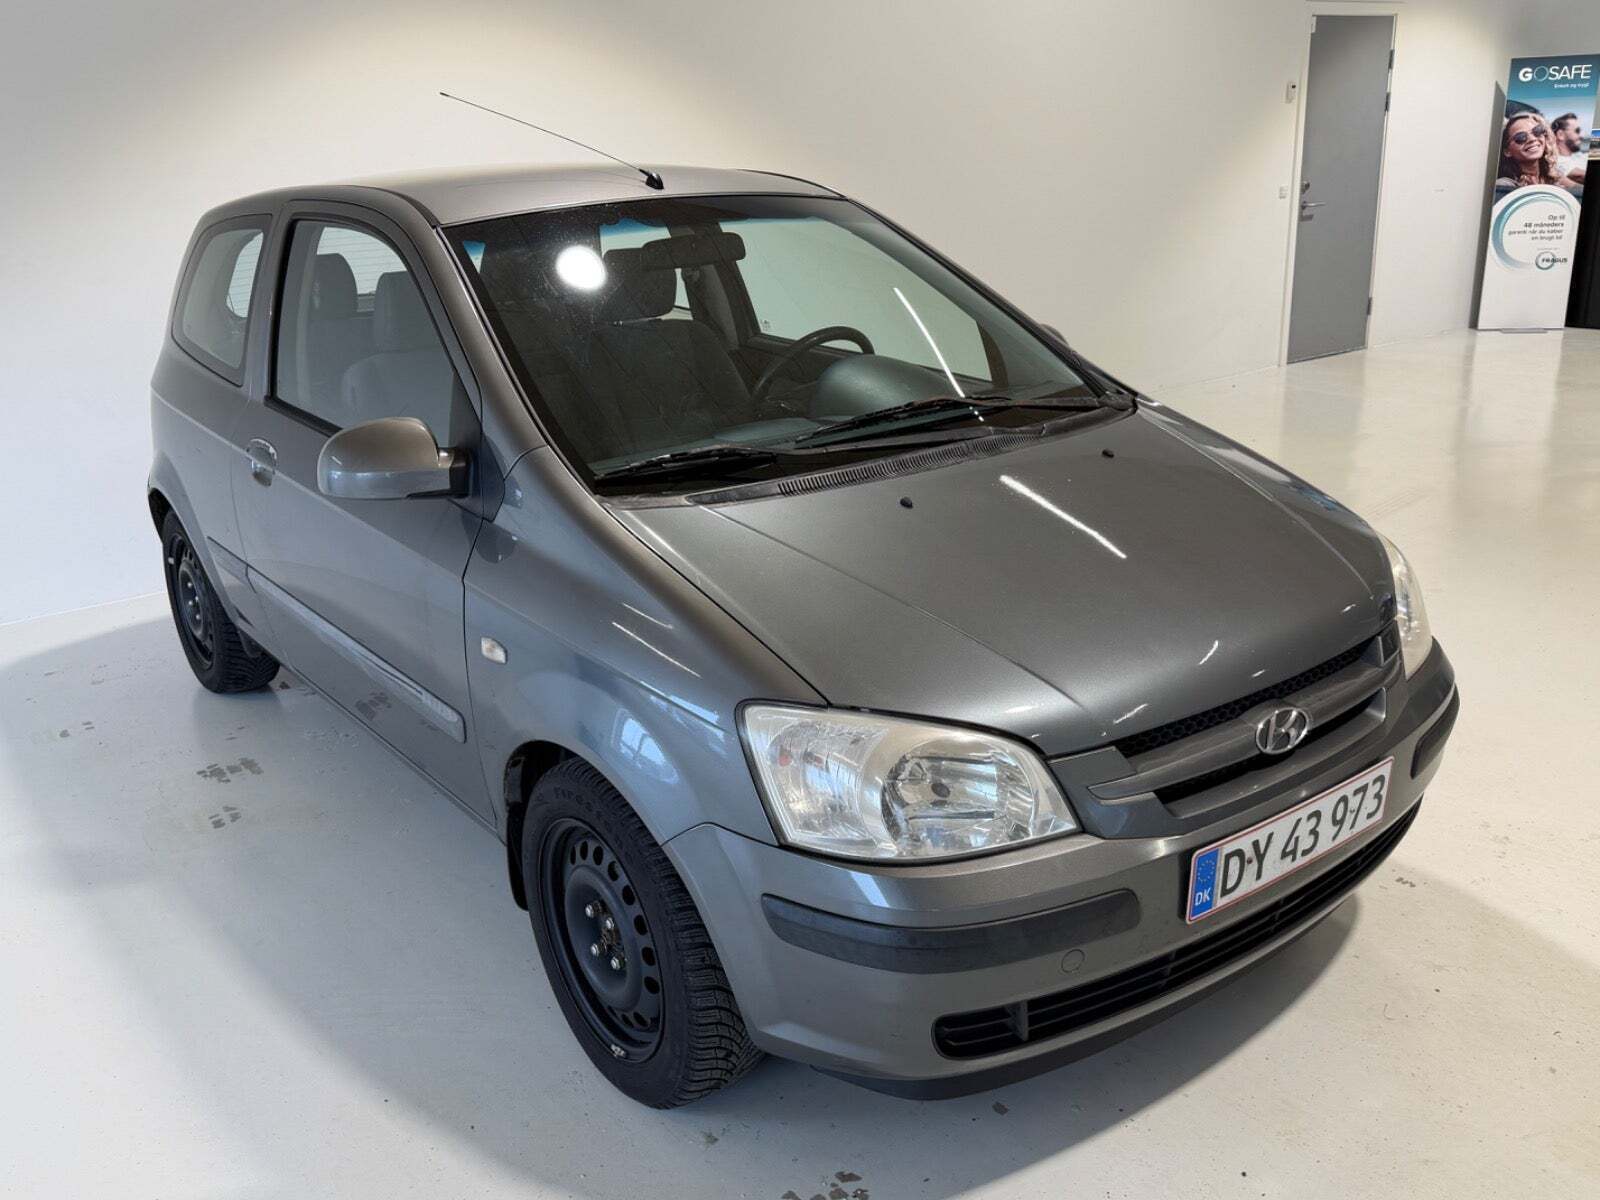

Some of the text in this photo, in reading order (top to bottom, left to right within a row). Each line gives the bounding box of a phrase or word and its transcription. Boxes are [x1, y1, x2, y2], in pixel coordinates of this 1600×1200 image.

[1518, 64, 1592, 82] GOSAFE
[1220, 774, 1386, 898] DY 43 973
[1194, 887, 1211, 906] DK
